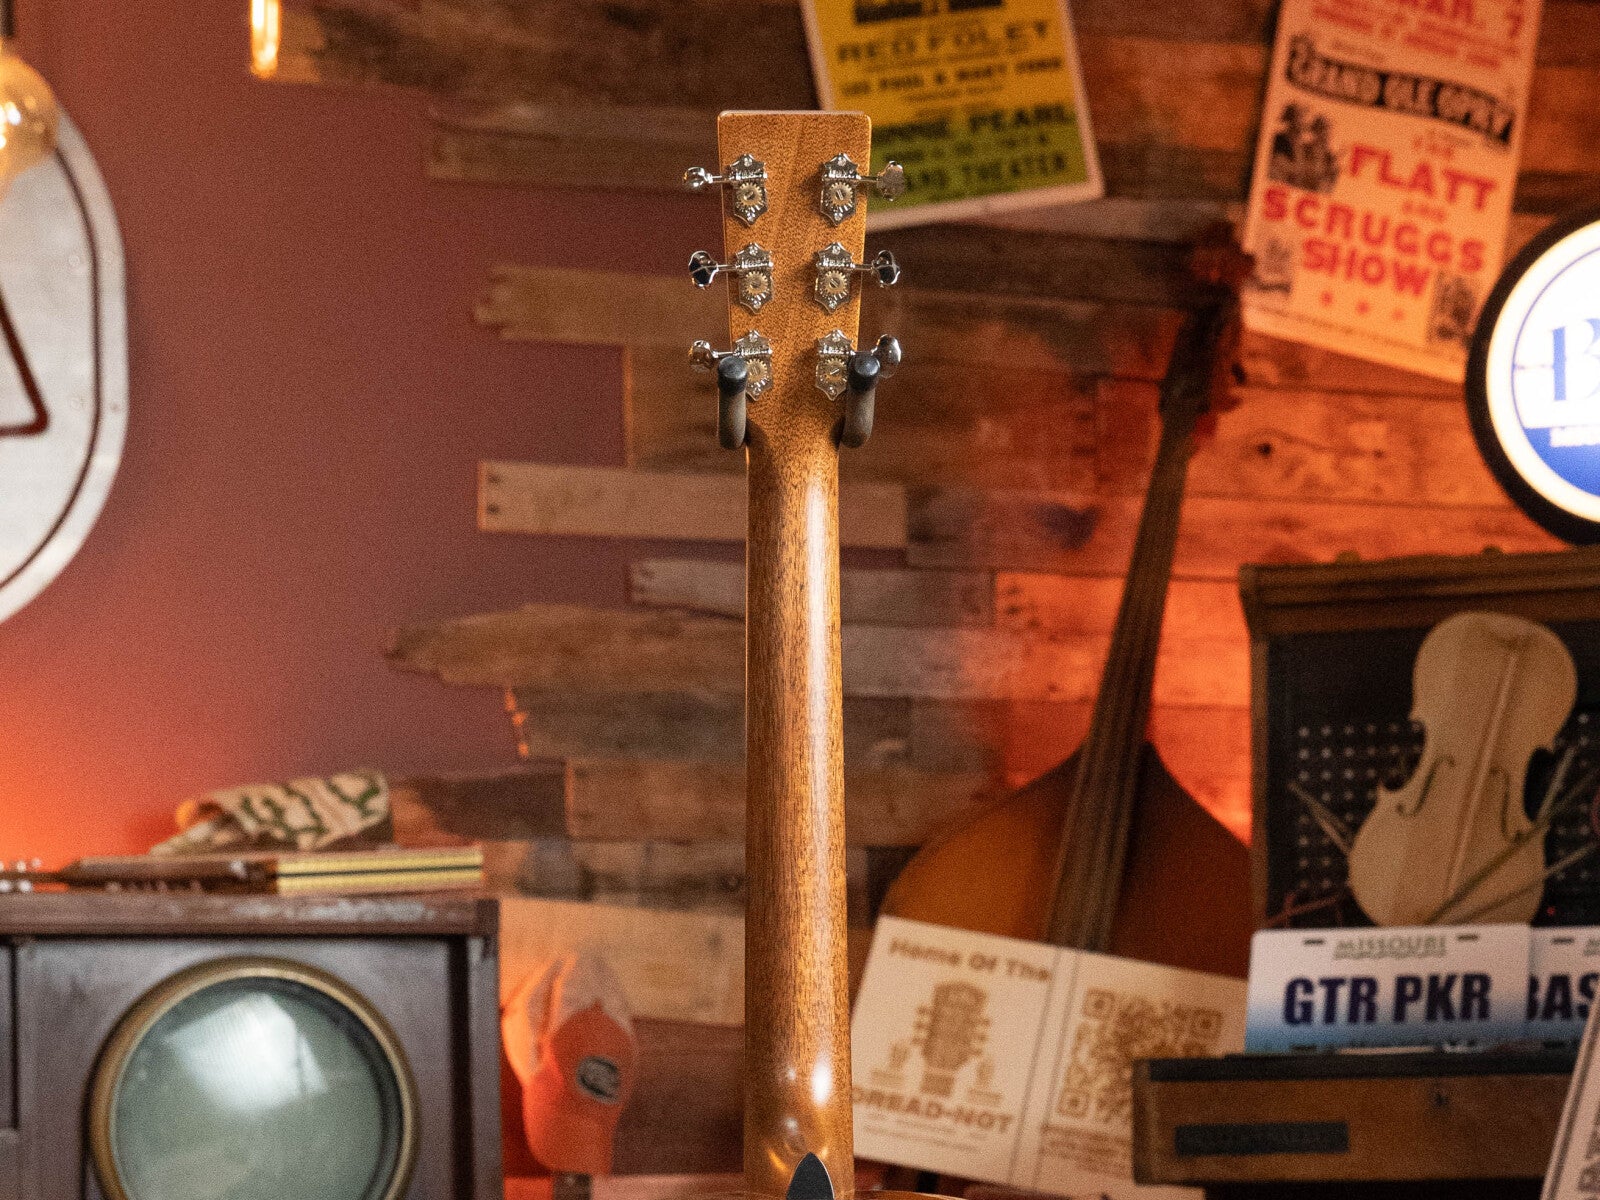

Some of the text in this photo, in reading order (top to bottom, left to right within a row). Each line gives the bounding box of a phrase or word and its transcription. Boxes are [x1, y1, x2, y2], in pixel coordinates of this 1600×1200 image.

[1350, 144, 1498, 212] FLATT
[1261, 186, 1486, 274] SCRUGGS
[1302, 238, 1431, 297] SHOW
[888, 938, 960, 965] Home
[1332, 935, 1448, 960] MISSOURI
[1282, 972, 1493, 1026] GTR PKR
